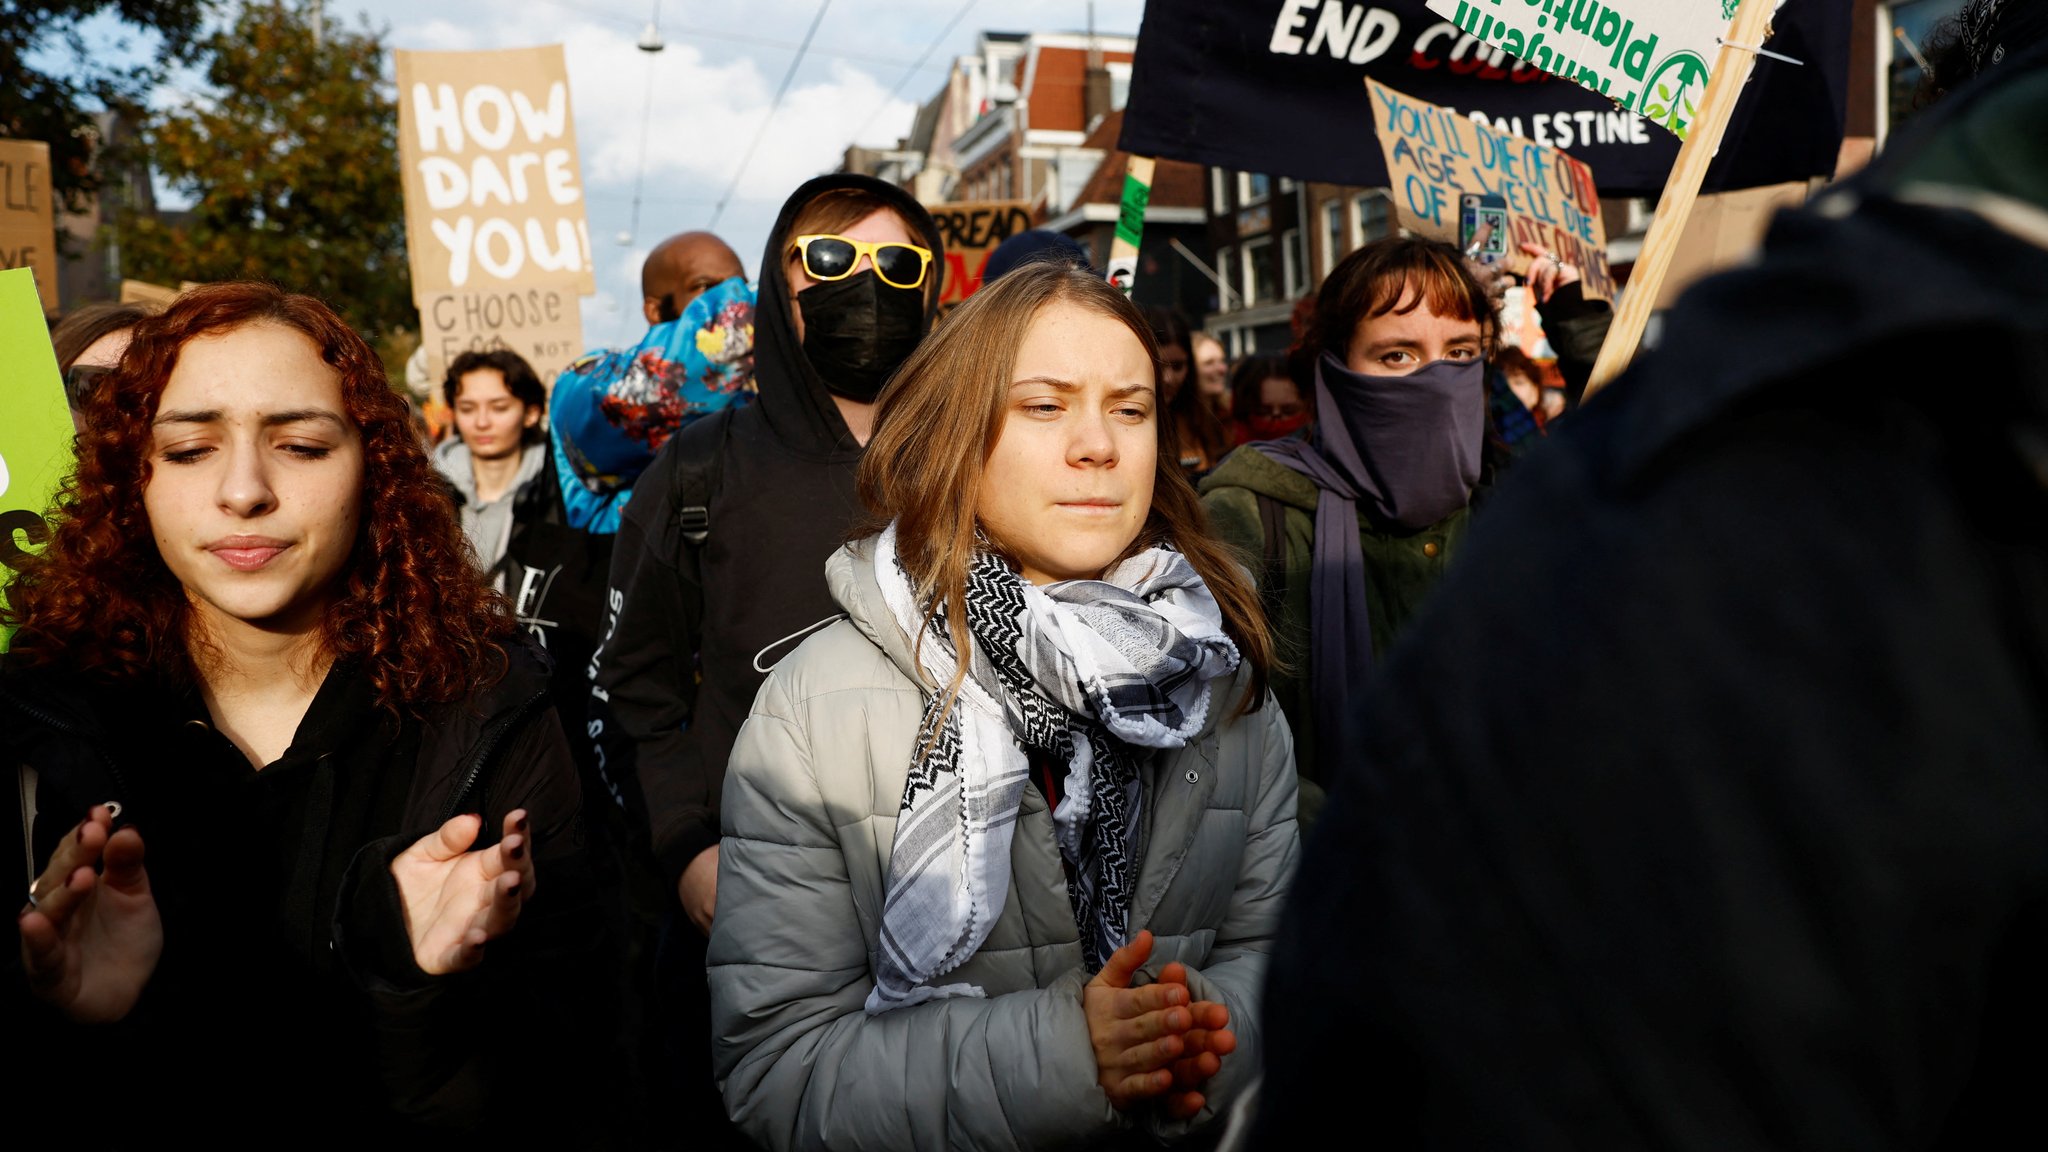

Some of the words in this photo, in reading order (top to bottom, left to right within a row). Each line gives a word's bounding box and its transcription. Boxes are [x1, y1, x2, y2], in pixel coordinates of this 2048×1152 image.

[1269, 0, 1400, 65] END
[412, 81, 566, 153] HOW
[1374, 85, 1470, 159] YOU'LL
[1476, 124, 1520, 180] DIE
[1393, 136, 1465, 193] AGE
[1404, 173, 1447, 228] OF
[431, 215, 594, 288] YOU!
[534, 341, 571, 358] NOT
